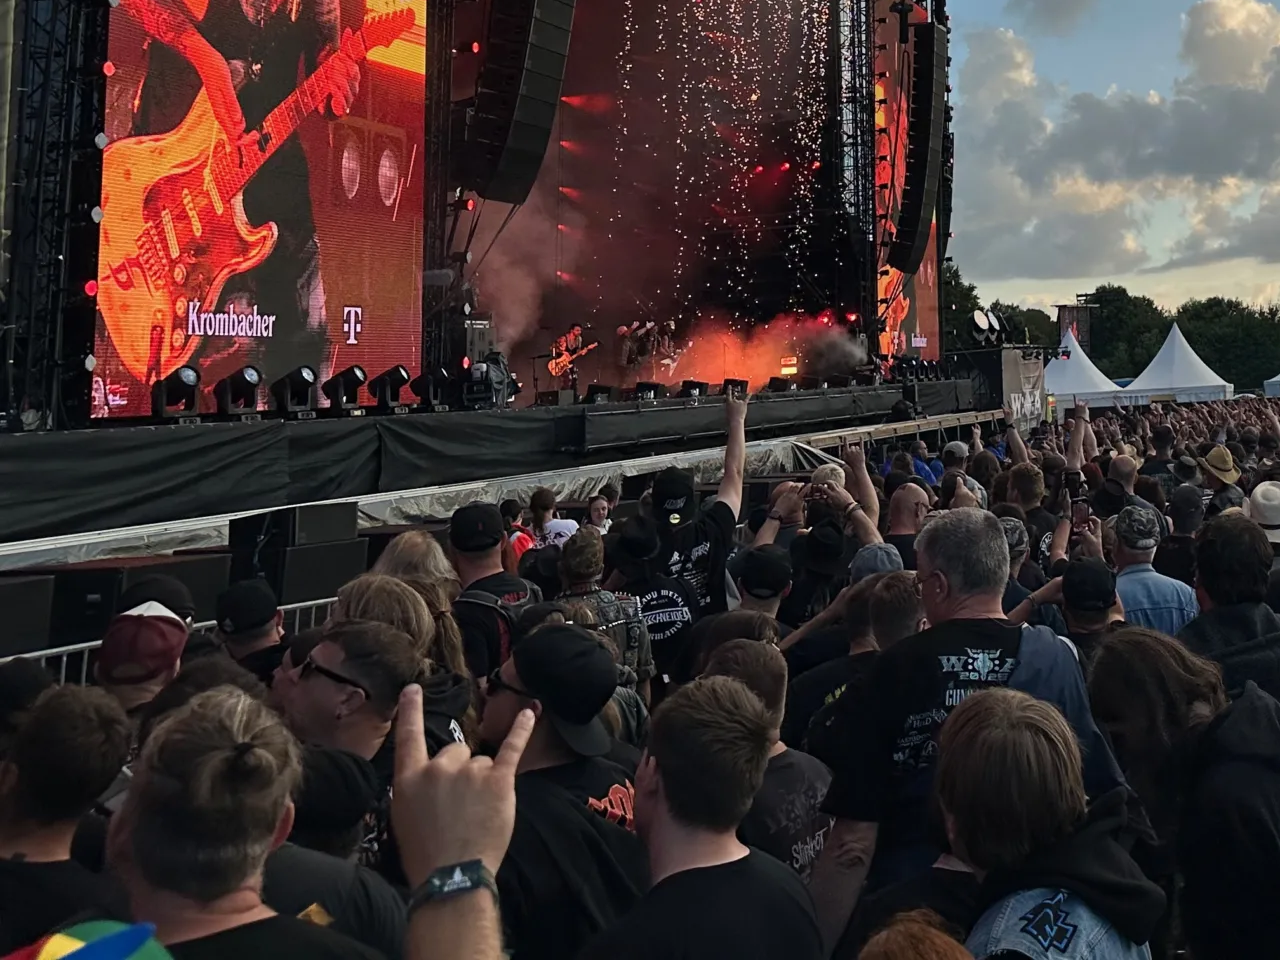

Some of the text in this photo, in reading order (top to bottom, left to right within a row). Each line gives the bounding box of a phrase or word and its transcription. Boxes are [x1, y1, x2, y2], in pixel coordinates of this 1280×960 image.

[187, 298, 361, 344] Krombacher T
[661, 589, 684, 607] METAL
